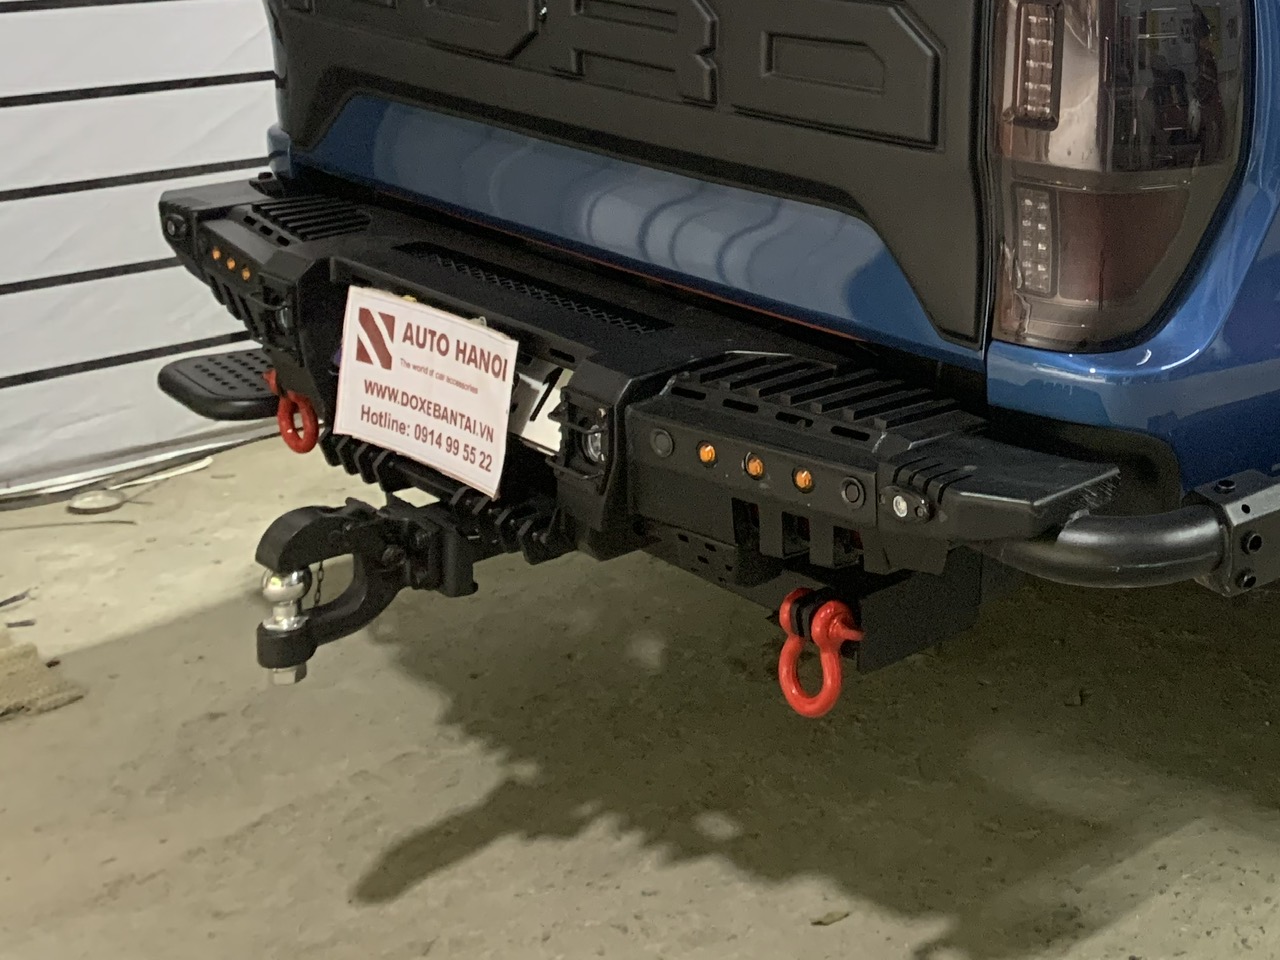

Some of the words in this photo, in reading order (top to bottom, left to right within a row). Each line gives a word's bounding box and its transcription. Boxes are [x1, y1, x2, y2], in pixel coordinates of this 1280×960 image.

[402, 322, 449, 356] AUTO
[455, 340, 508, 382] HANOI
[361, 404, 410, 437] Hotline:
[414, 423, 442, 449] 0914
[446, 436, 459, 456] 99
[463, 444, 476, 464] 55
[479, 451, 492, 472] 22
[364, 379, 494, 443] WWW.DOXEBANTAI.VN
